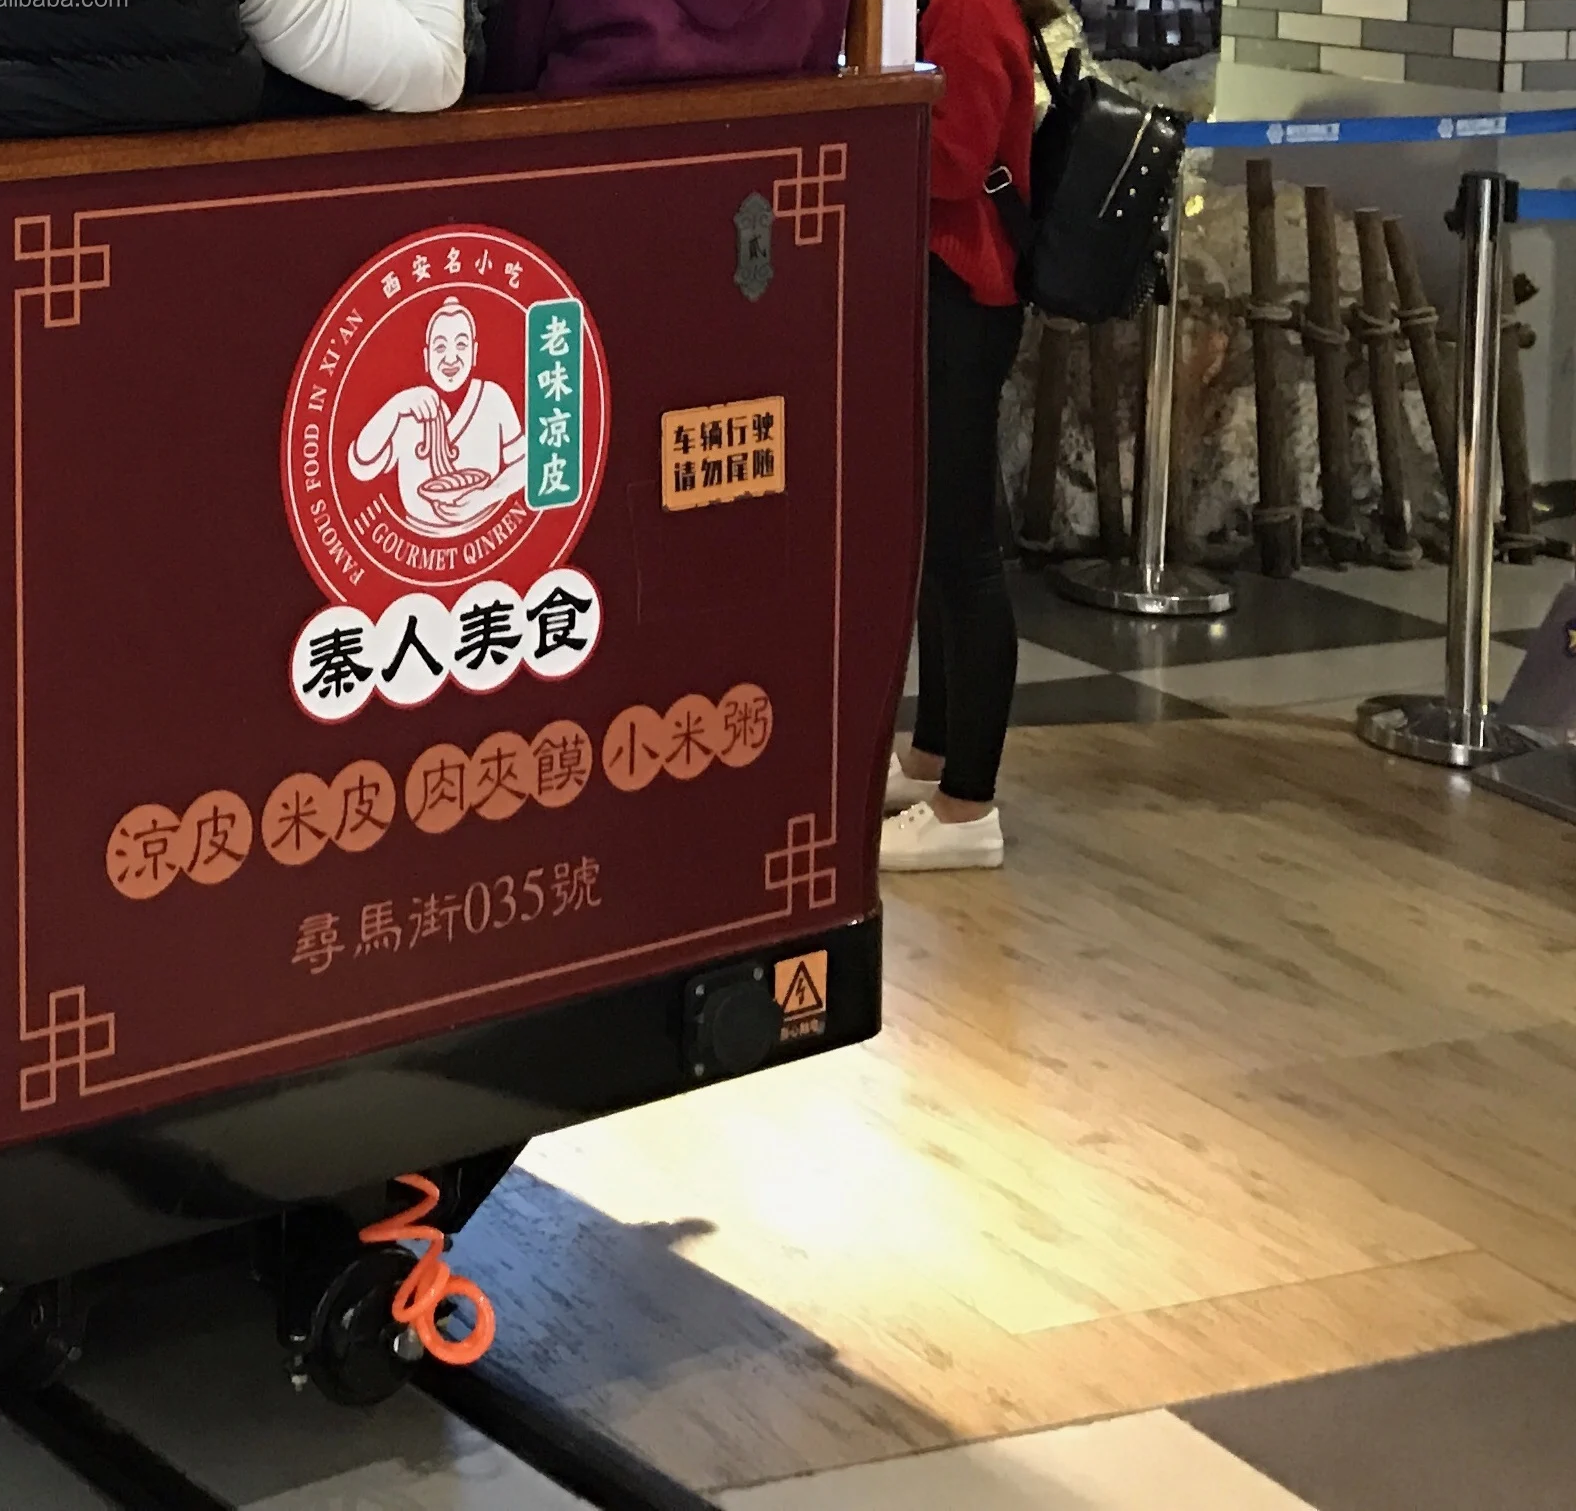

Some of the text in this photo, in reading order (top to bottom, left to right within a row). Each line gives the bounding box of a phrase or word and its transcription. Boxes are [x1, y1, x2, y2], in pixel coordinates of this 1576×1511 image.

[382, 247, 524, 299] 西安名小吃
[308, 384, 328, 412] IN
[537, 315, 573, 497] 老味凉皮
[673, 411, 774, 455] 车辆行驶
[304, 422, 322, 493] FOOD
[310, 498, 366, 586] FAMOUS
[372, 500, 529, 572] GOURMET QINREN
[303, 586, 593, 699] 秦人美食
[270, 774, 391, 851] 米皮
[608, 695, 770, 777] 小米粥
